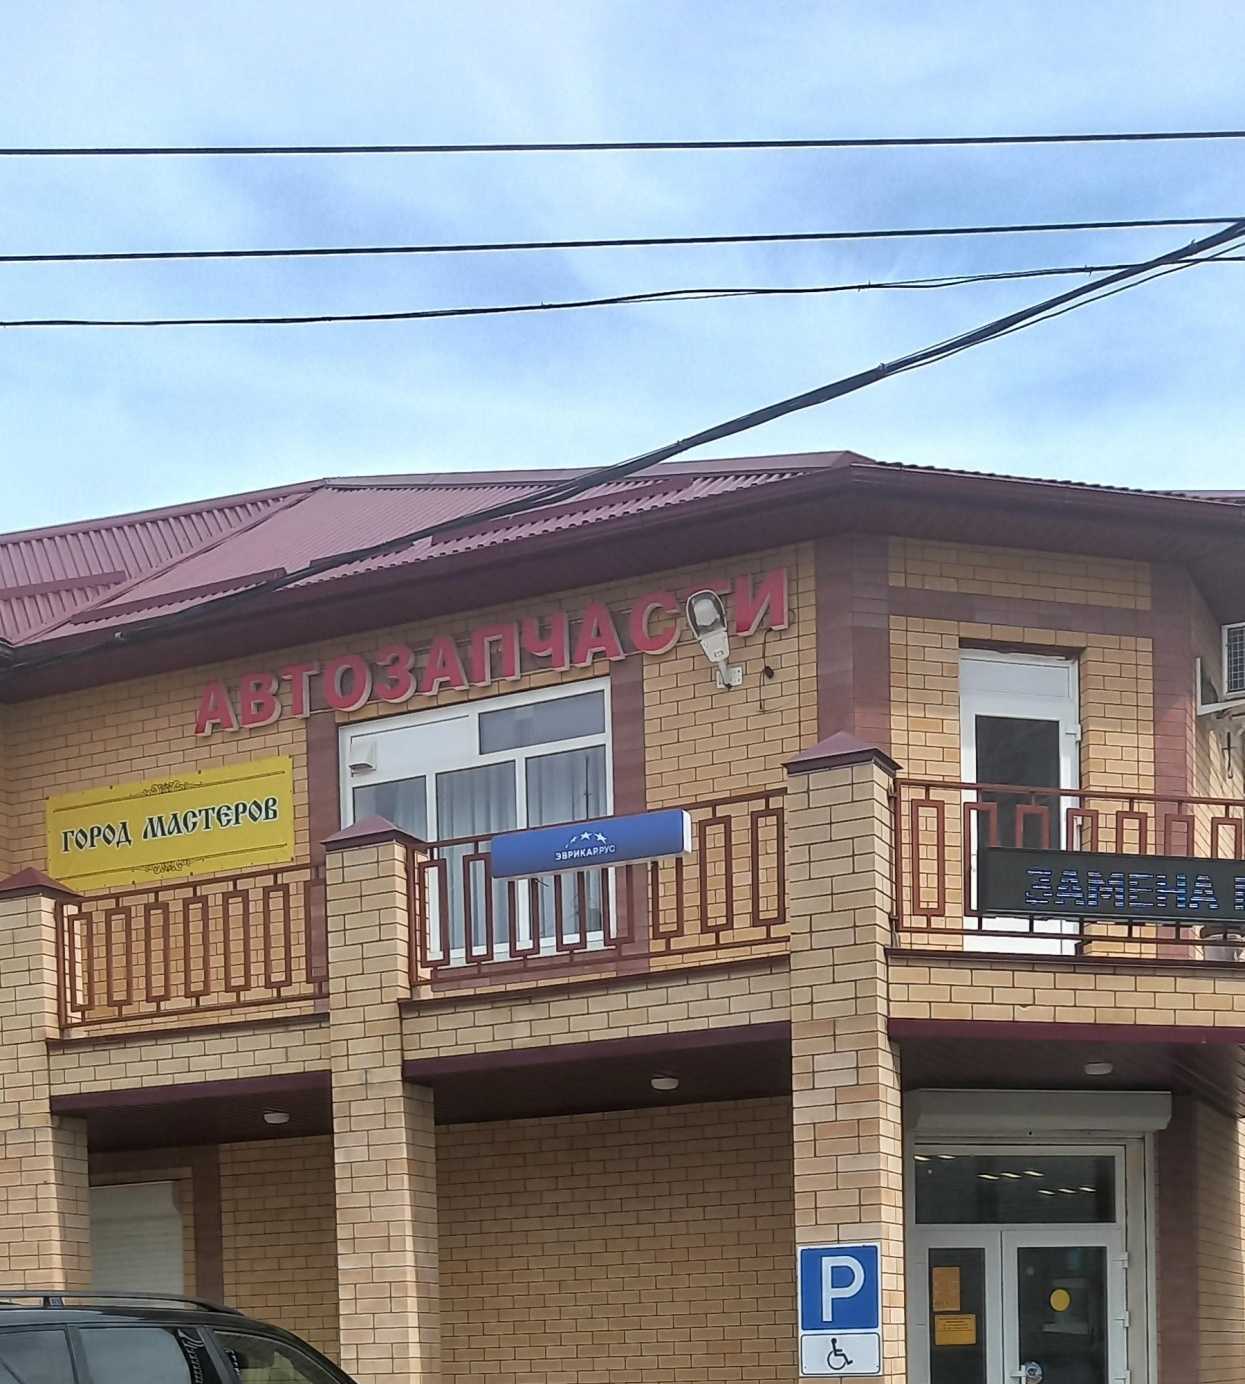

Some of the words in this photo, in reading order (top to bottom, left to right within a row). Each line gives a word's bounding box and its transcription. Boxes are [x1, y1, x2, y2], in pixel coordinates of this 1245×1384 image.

[61, 821, 132, 852] ГОРОД
[142, 796, 278, 840] МАСТЕРОВ
[555, 844, 616, 861] ЭВРИКАРРУС
[1026, 869, 1218, 910] ЗАМЕНА
[821, 1255, 864, 1322] P
